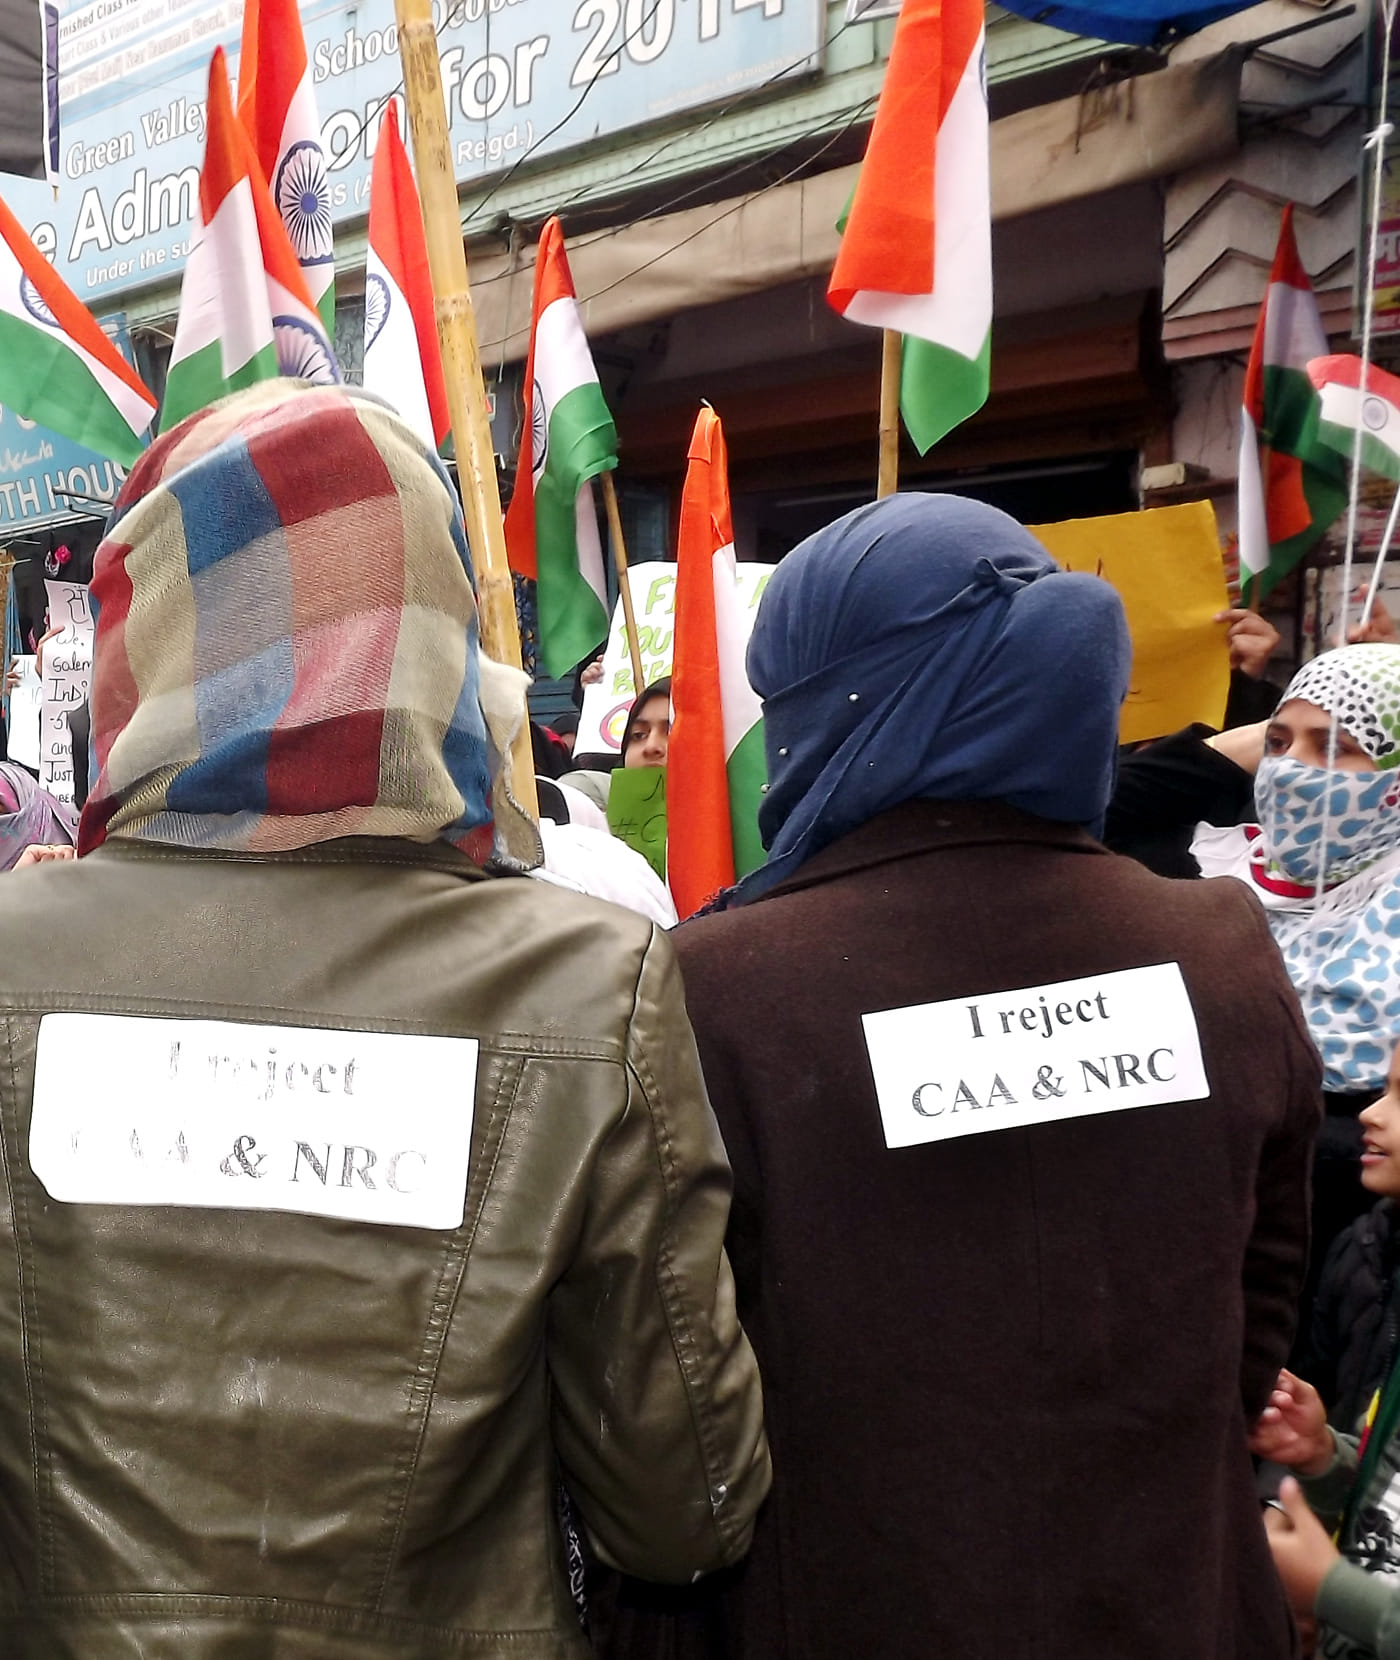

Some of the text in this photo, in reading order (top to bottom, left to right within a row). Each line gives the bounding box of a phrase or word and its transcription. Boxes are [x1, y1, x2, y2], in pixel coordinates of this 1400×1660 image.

[59, 9, 94, 39] rnished
[438, 35, 551, 130] for
[568, 0, 784, 89] 201
[66, 28, 400, 180] Green Valley Schoo
[457, 120, 534, 167] Regd.)
[86, 255, 135, 288] Under
[139, 243, 167, 270] the
[44, 461, 128, 510] HOUS
[965, 991, 1111, 1039] I reject
[912, 1047, 1177, 1117] CAA & NRC
[219, 1135, 269, 1179] &
[288, 1140, 428, 1194] NRC
